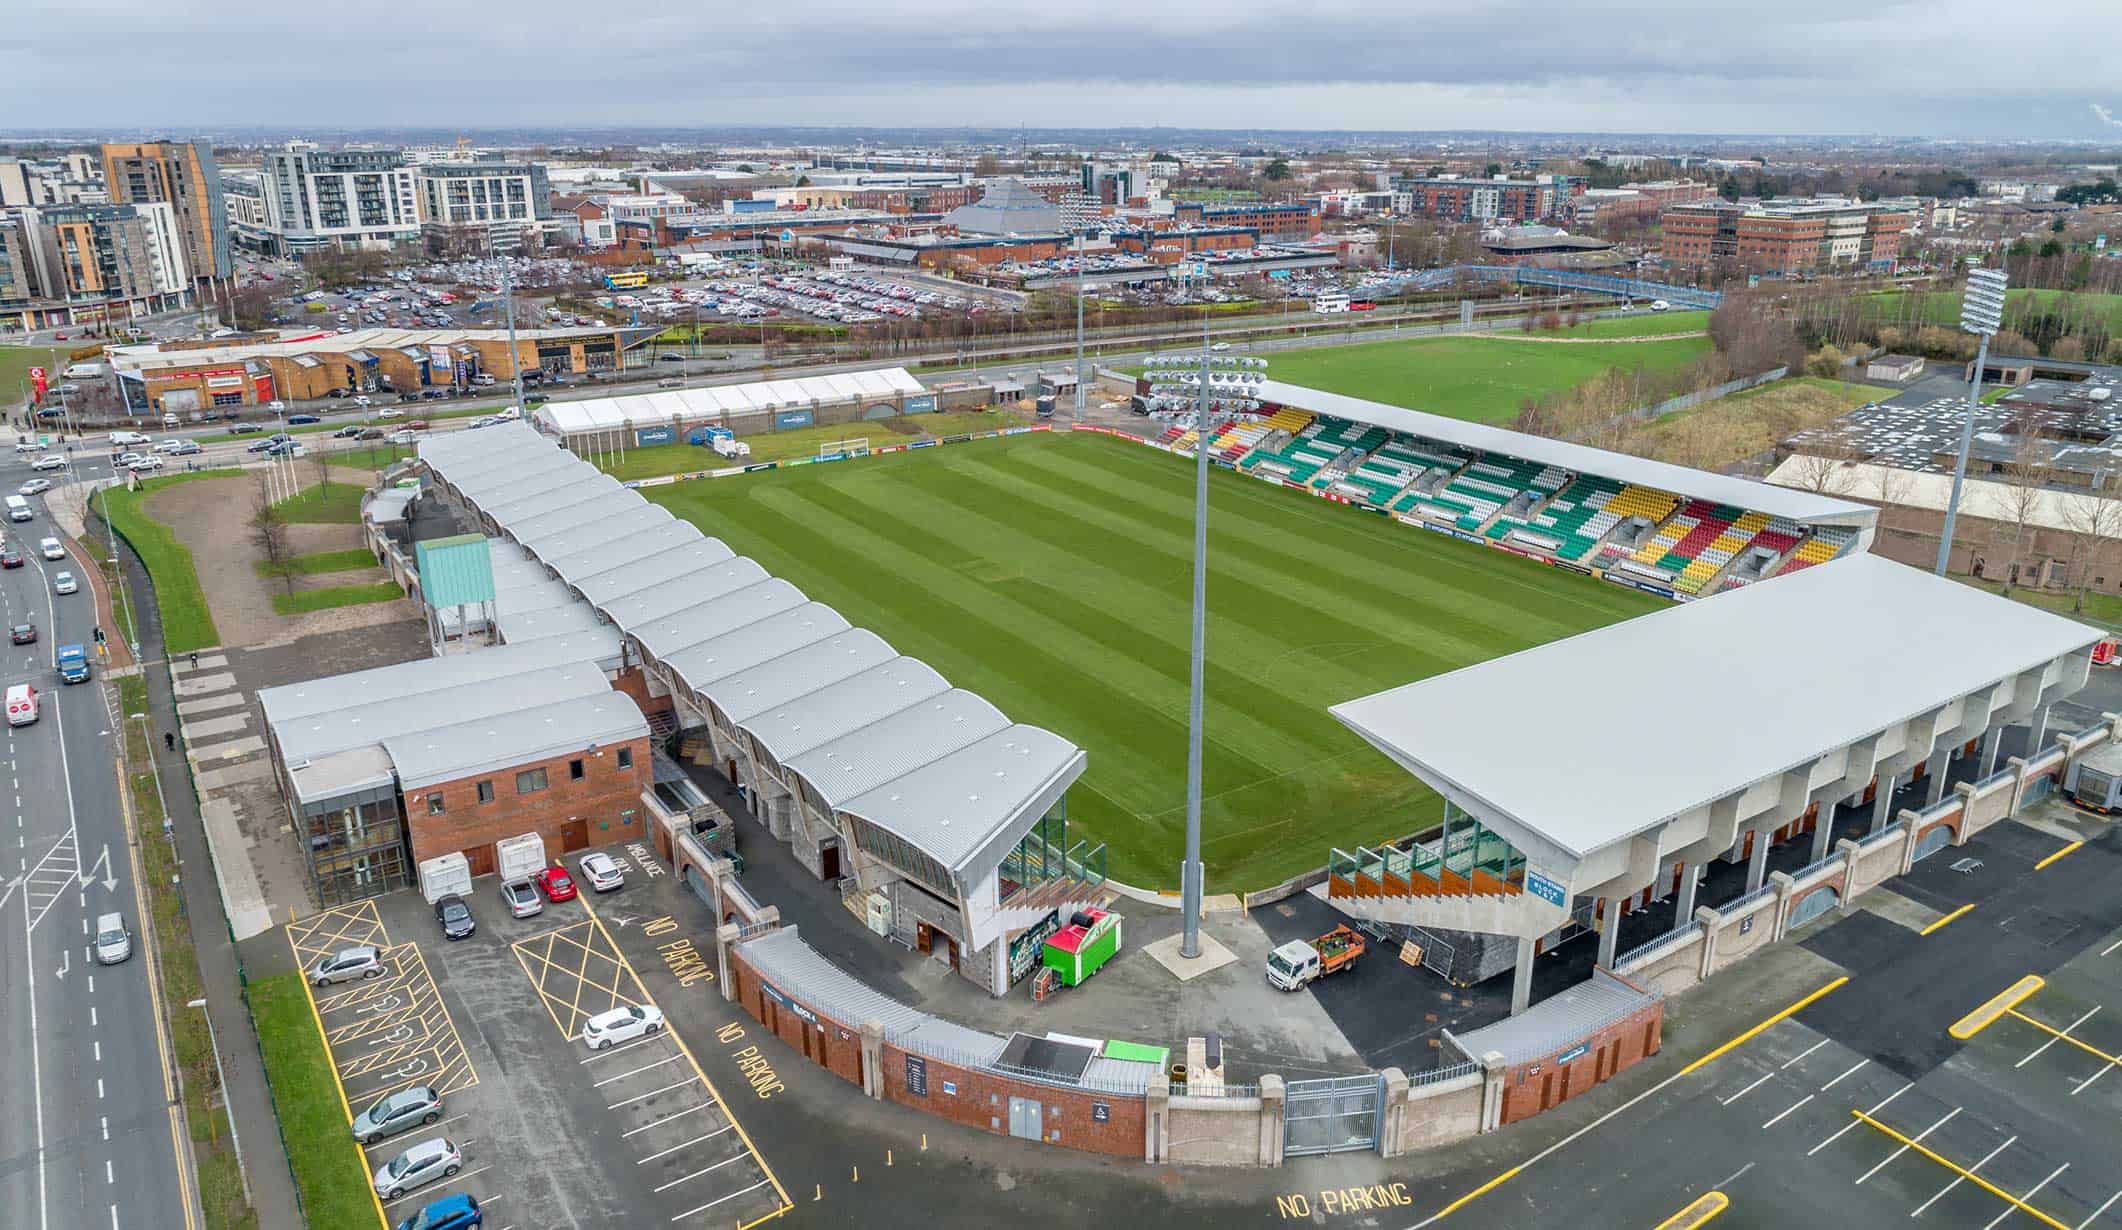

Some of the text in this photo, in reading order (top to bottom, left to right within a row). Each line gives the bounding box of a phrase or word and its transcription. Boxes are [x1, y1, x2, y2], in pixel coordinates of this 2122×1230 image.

[640, 915, 715, 988] NO PARKING
[715, 1021, 745, 1044] NO
[732, 1046, 785, 1099] PARKING
[1276, 1182, 1412, 1219] NO PARKING
